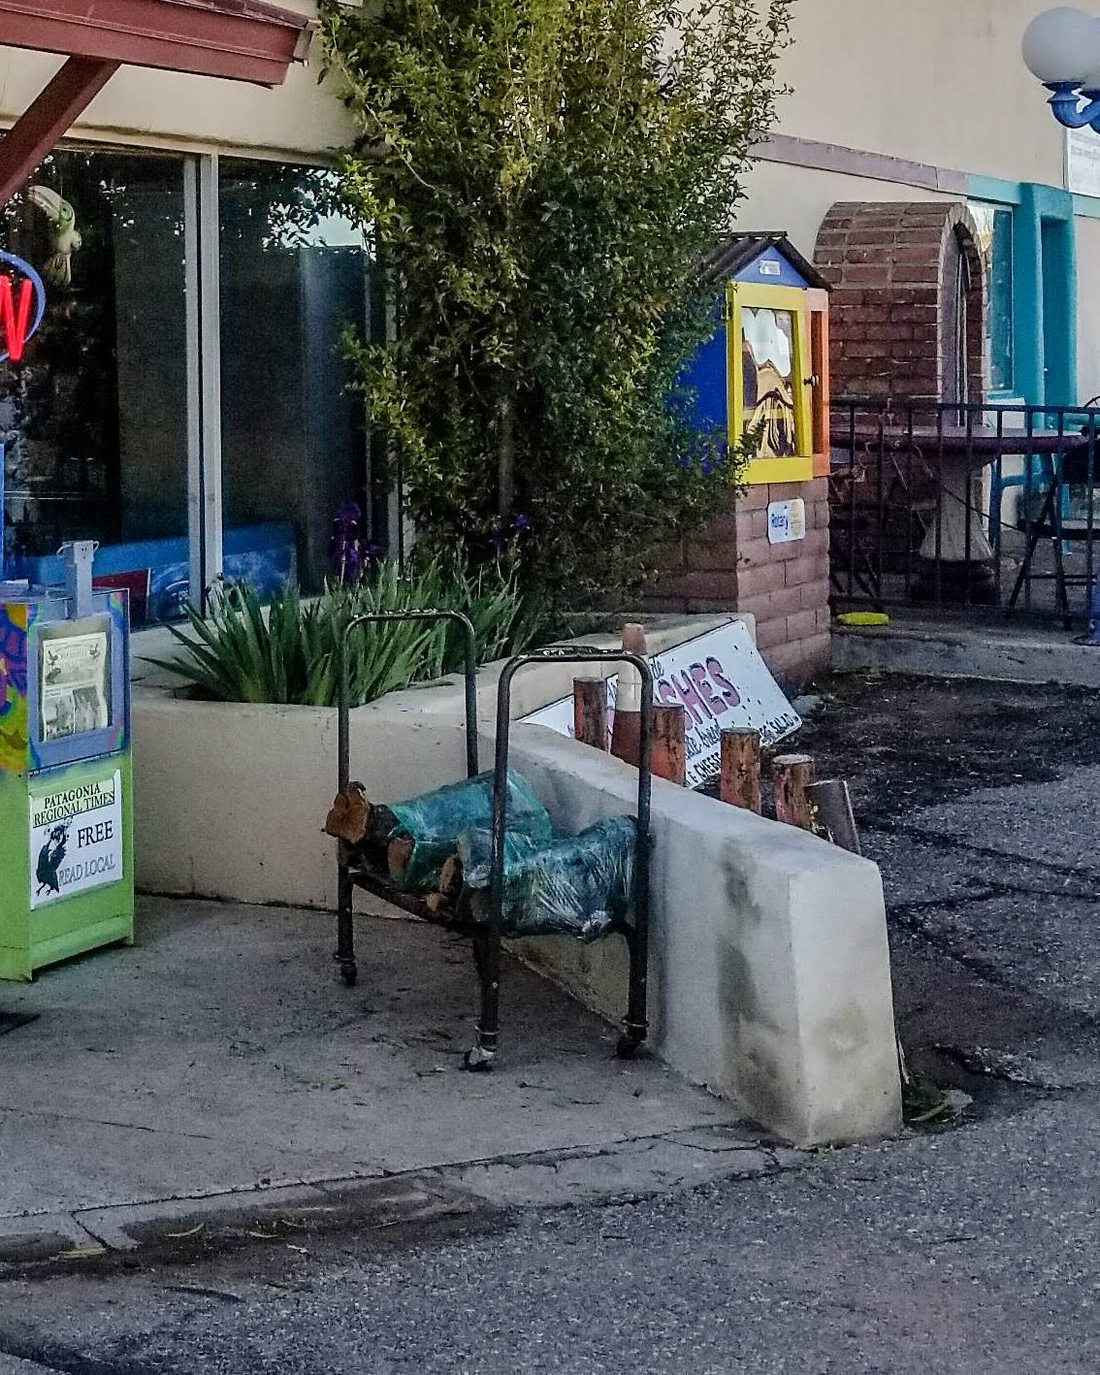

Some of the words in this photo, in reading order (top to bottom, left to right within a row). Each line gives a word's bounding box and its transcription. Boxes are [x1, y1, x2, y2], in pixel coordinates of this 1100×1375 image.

[34, 801, 83, 826] REGIONAL
[84, 791, 115, 810] TIMES
[44, 782, 101, 809] PATAGONIA
[77, 820, 114, 848] FREE
[58, 864, 84, 887] READ
[85, 854, 116, 876] LOCAL
